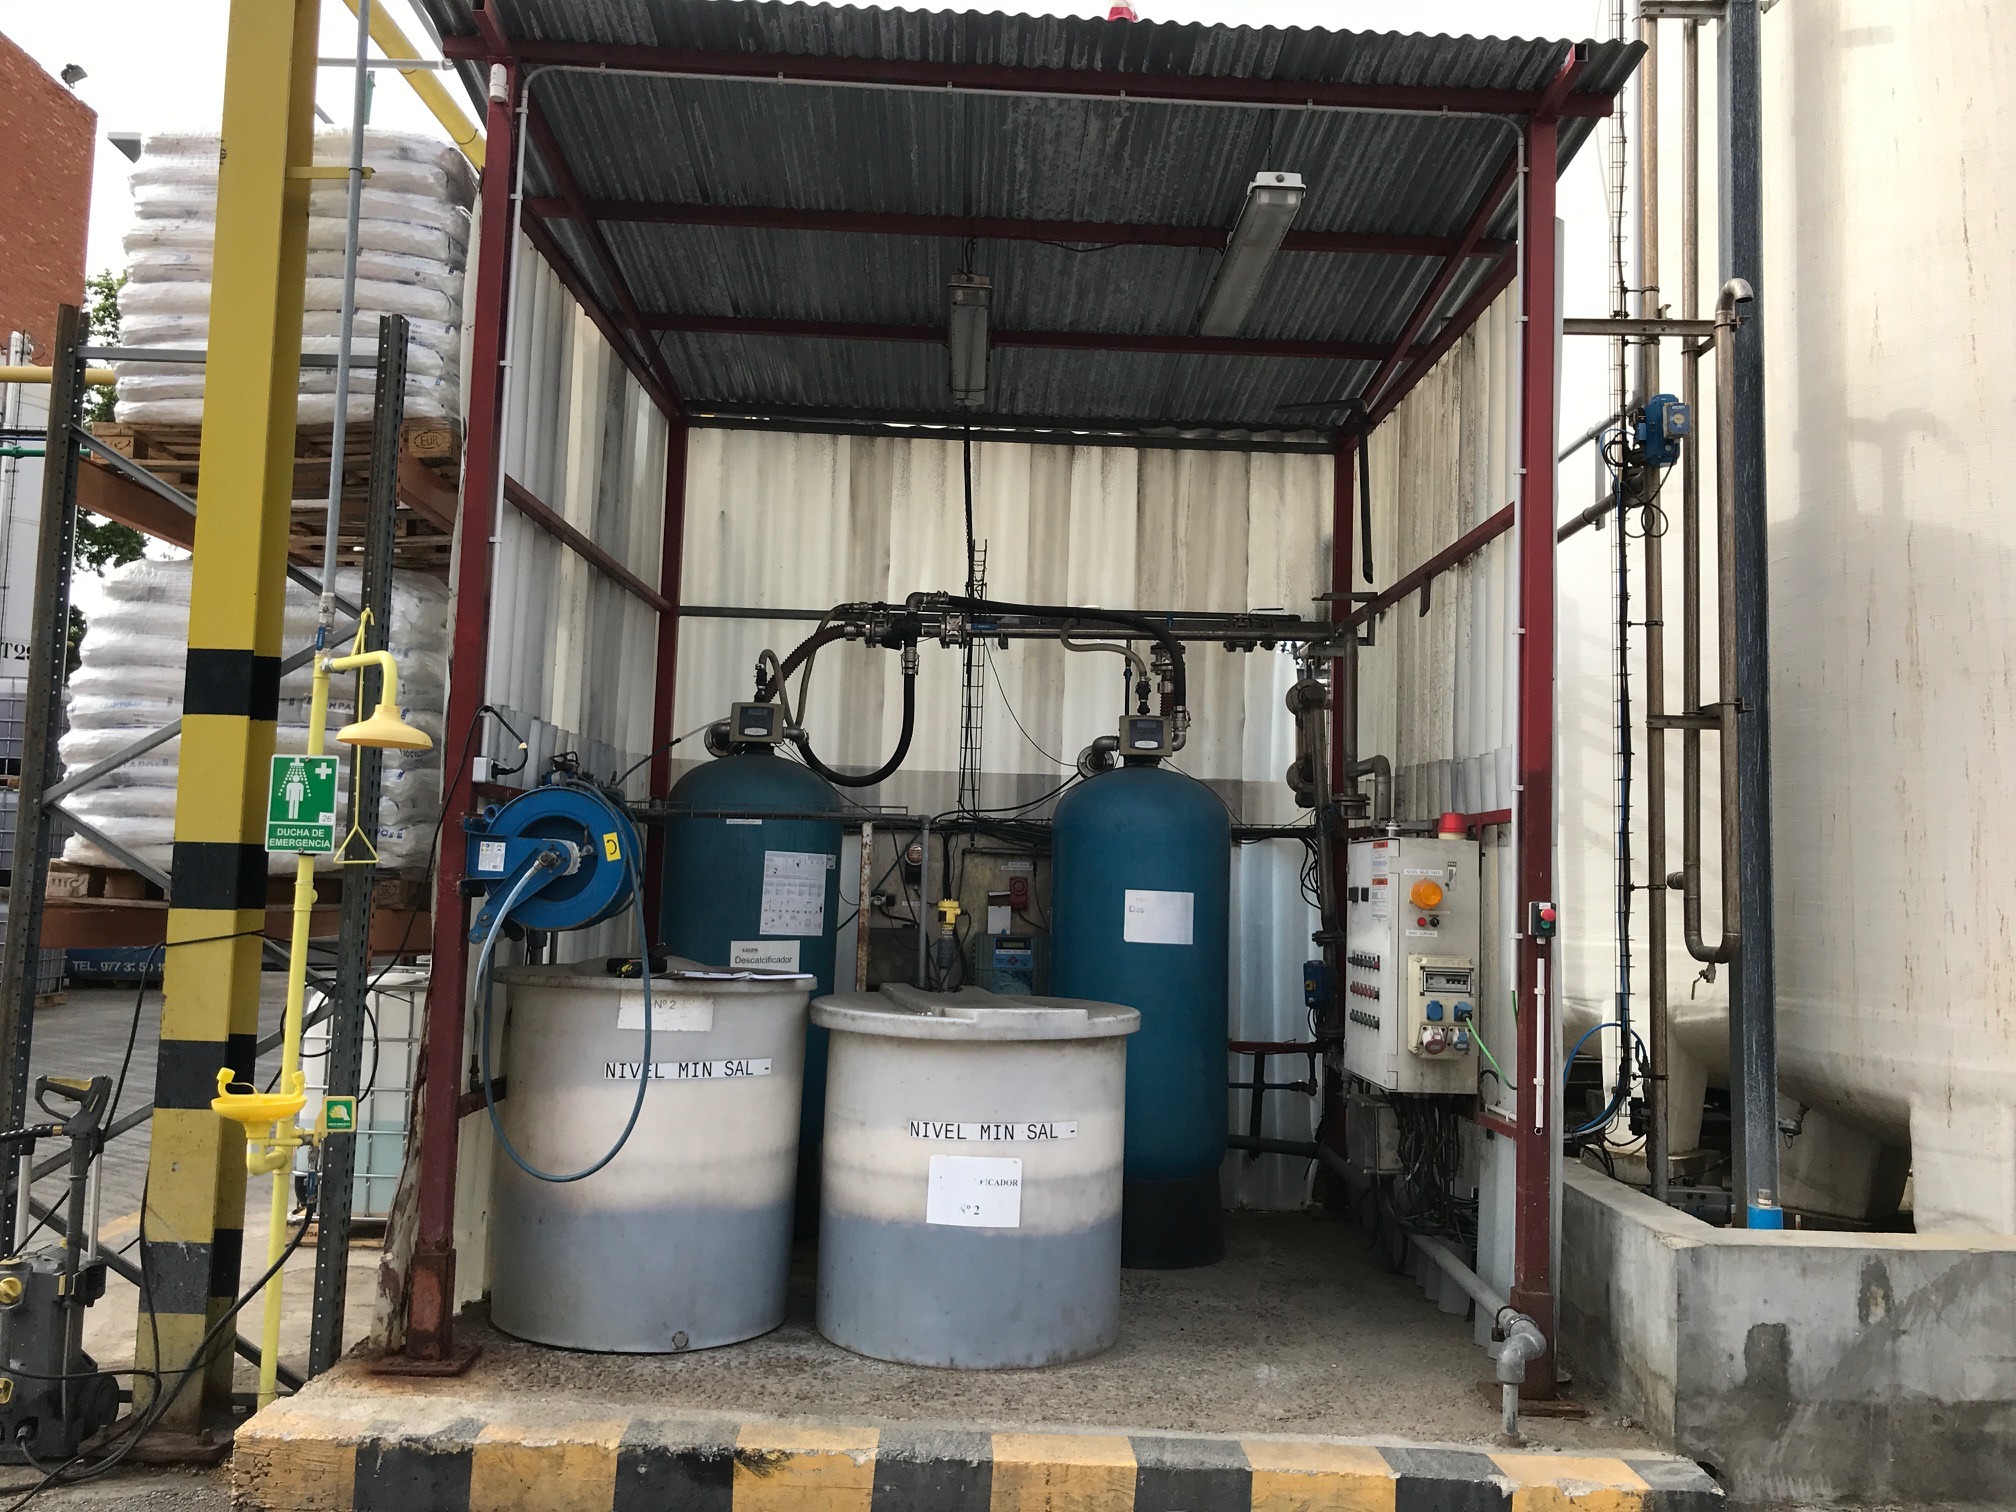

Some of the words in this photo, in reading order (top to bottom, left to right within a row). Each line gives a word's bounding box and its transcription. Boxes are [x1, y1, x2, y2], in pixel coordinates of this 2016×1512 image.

[321, 814, 332, 823] 26
[276, 827, 310, 837] DUCHA
[311, 828, 325, 838] DE
[268, 838, 331, 848] EMERGENCIA
[734, 954, 793, 965] Descalcificador
[72, 961, 97, 972] TEL.
[100, 961, 121, 972] 977
[669, 1000, 677, 1010] 2
[678, 1061, 713, 1078] MIN
[724, 1060, 754, 1077] SAL
[910, 1121, 967, 1140] NIVEL
[980, 1124, 1015, 1140] MIN
[1027, 1123, 1059, 1140] SAL
[973, 1205, 980, 1216] 2
